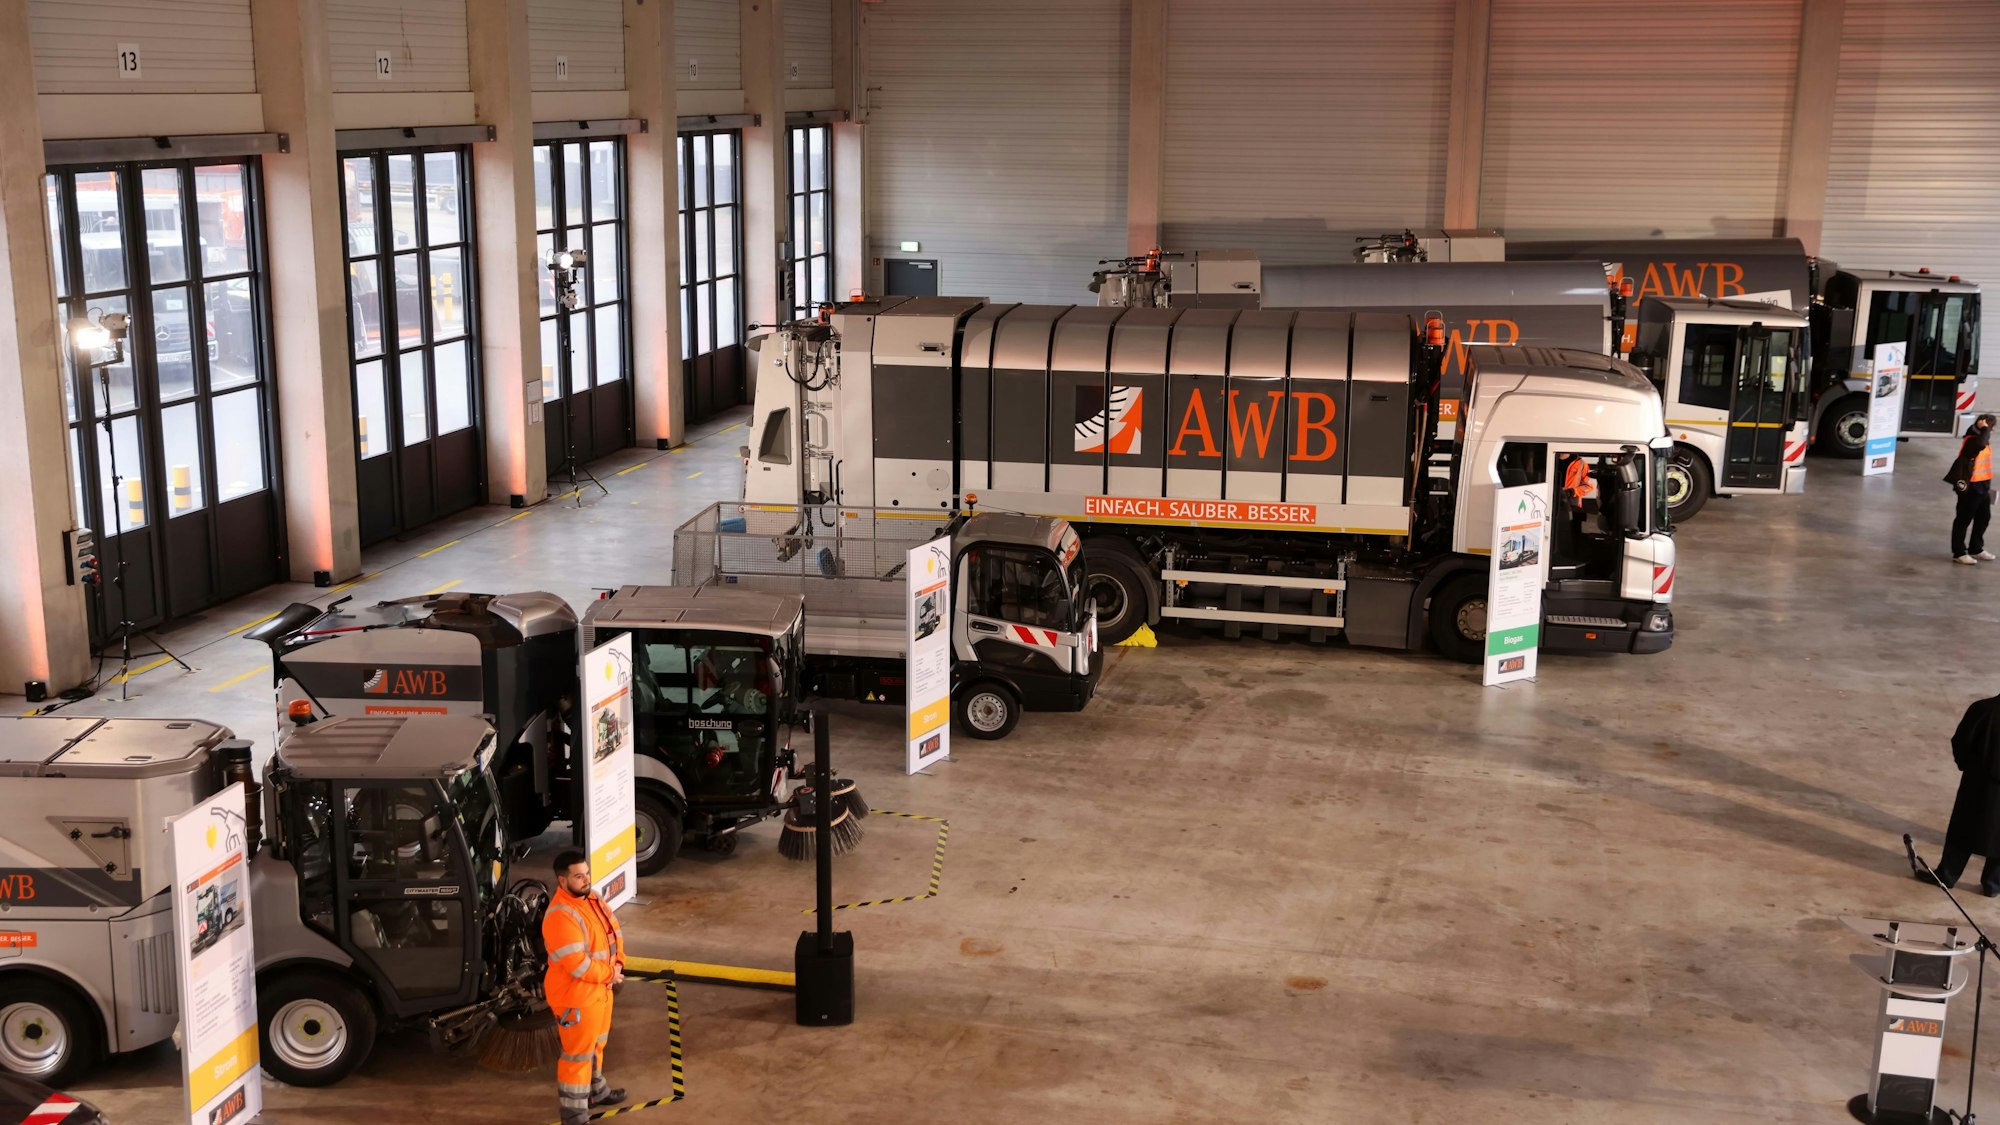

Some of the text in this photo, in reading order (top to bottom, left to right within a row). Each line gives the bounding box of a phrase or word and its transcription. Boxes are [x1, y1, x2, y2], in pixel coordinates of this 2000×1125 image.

[121, 52, 137, 71] 13
[378, 58, 389, 74] 12
[558, 61, 566, 75] 11
[690, 64, 697, 77] 10
[1632, 262, 1746, 307] AWB
[1168, 388, 1338, 462] AWB
[1086, 499, 1316, 523] EINFACH. SAUBER. BESSER.
[1504, 635, 1524, 645] Biogas
[1508, 658, 1523, 670] AWB
[392, 669, 447, 695] AWB
[688, 717, 732, 729] boschung
[927, 736, 939, 752] AWB
[0, 874, 35, 900] WB
[610, 875, 624, 896] AWB
[1905, 1019, 1938, 1035] AWB
[222, 1091, 243, 1121] AWB
